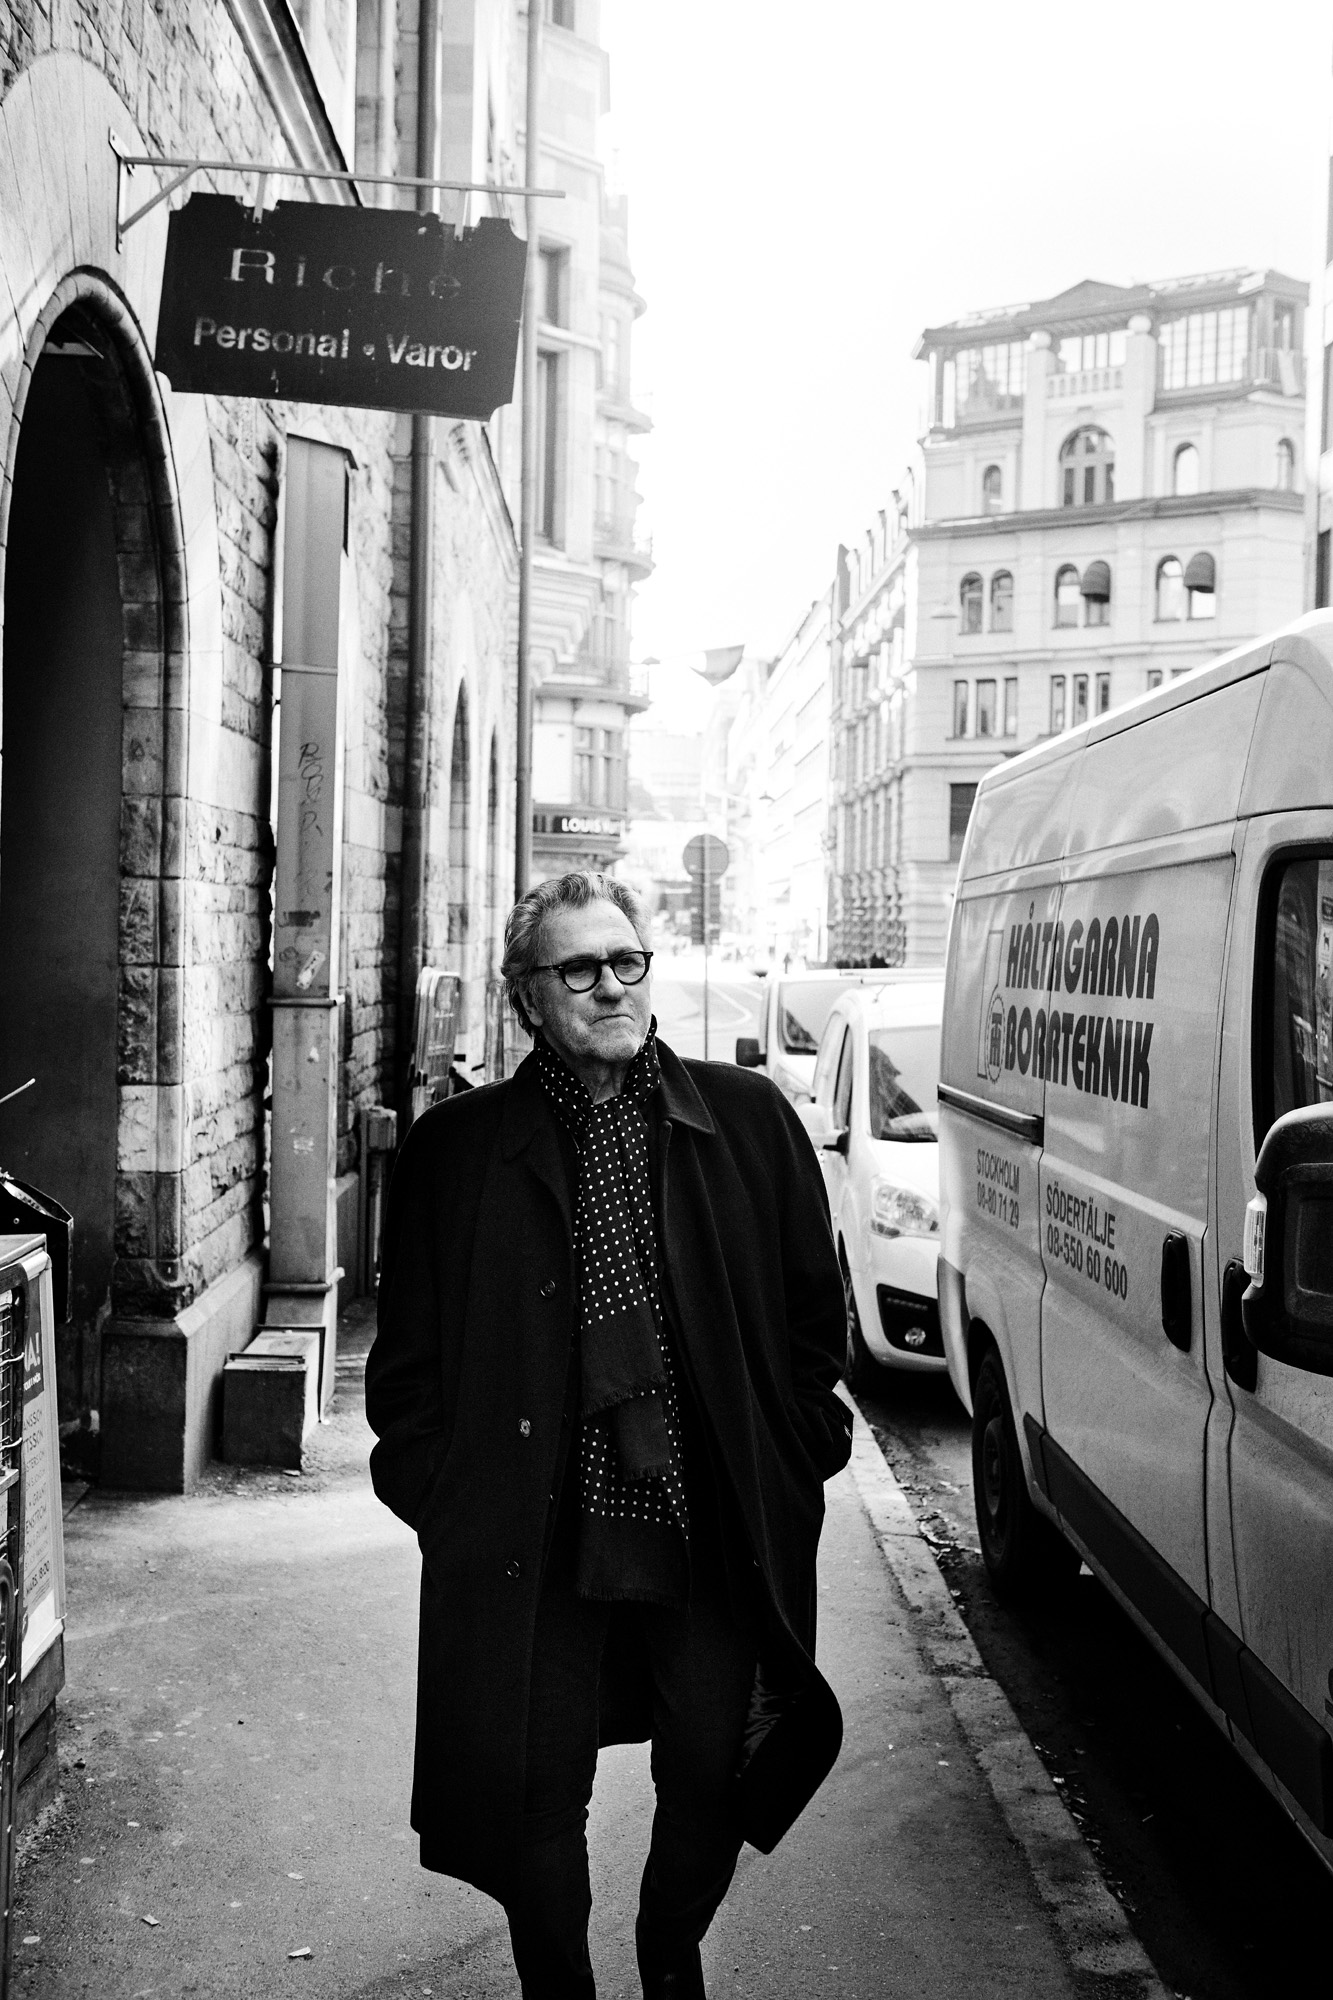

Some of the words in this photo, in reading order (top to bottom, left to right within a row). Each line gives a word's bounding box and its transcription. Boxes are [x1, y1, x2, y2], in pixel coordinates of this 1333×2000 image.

[193, 316, 350, 359] Personal
[386, 333, 477, 372] Varor
[1005, 901, 1160, 1000] HÅLTAGARNA
[1004, 1005, 1154, 1109] BORRTEKNIK
[976, 1149, 1020, 1194] STOCKHOLM
[1046, 1181, 1116, 1250] SÖDERTÄLJE
[1047, 1223, 1083, 1273] 08-550
[1086, 1245, 1101, 1284] 60
[1104, 1256, 1128, 1301] 600
